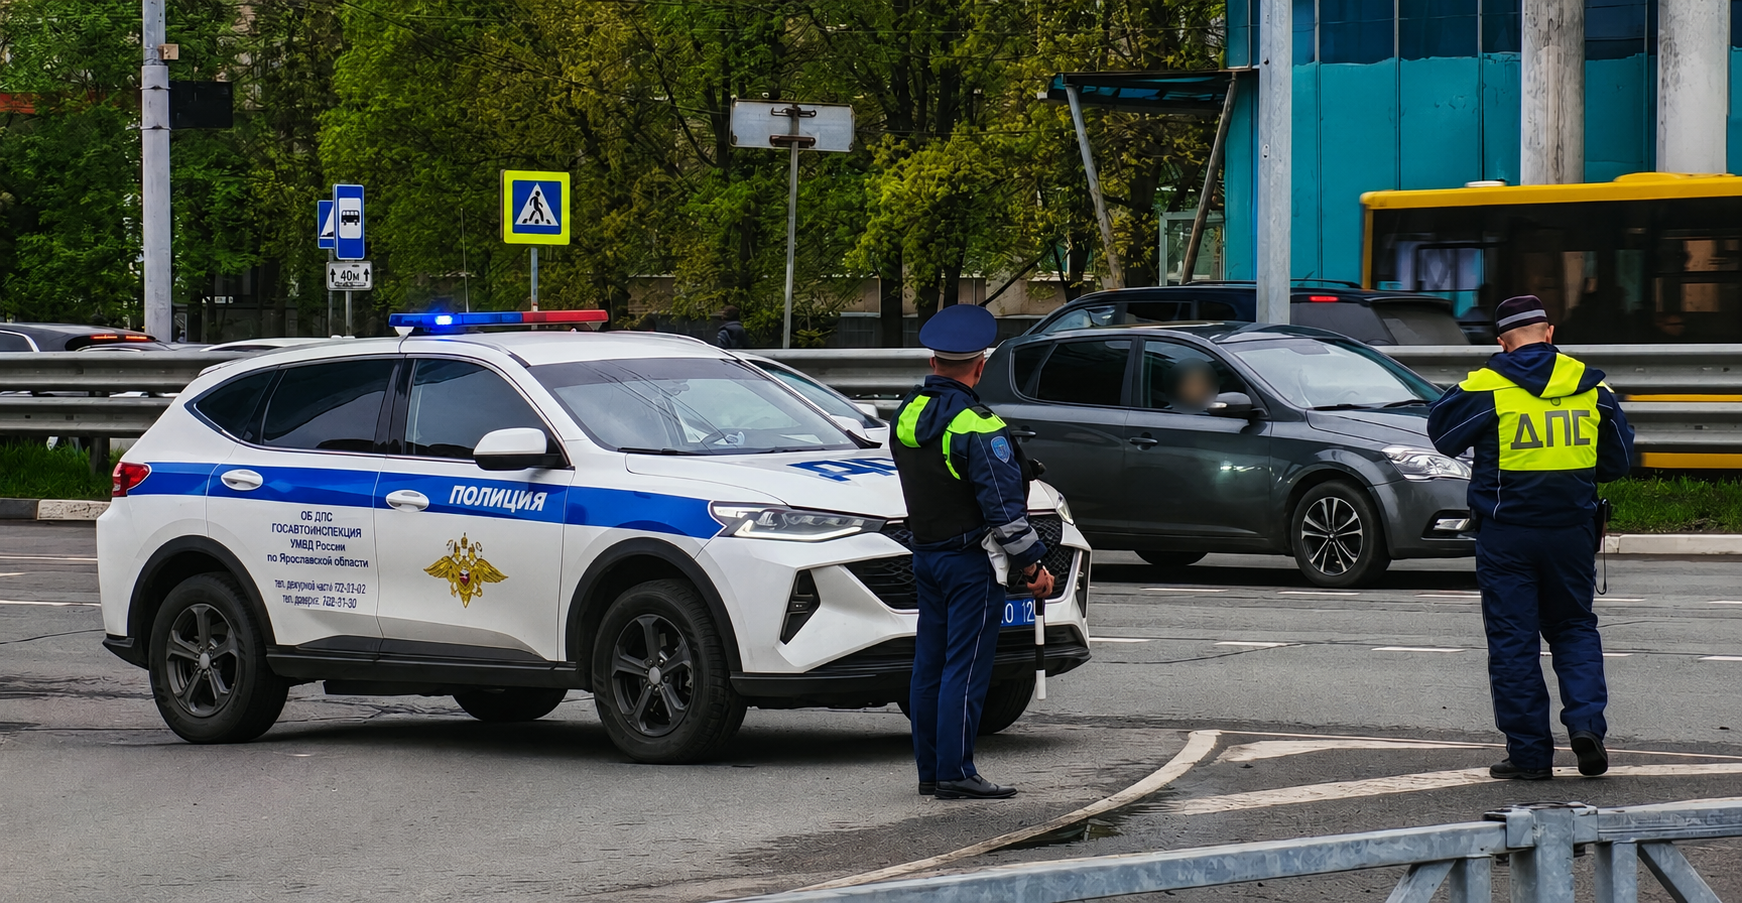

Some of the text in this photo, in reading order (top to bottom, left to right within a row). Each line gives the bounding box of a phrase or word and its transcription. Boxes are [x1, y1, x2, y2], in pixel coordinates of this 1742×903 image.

[1510, 409, 1591, 450] ДПС
[448, 485, 548, 513] ПОЛИЦИЯ
[300, 510, 333, 522] ОБ ДПС
[271, 522, 362, 539] ГОСАВТОИНСПЕКЦИЯ
[290, 538, 346, 552] УМВД России
[267, 552, 369, 568] по Ярославской области
